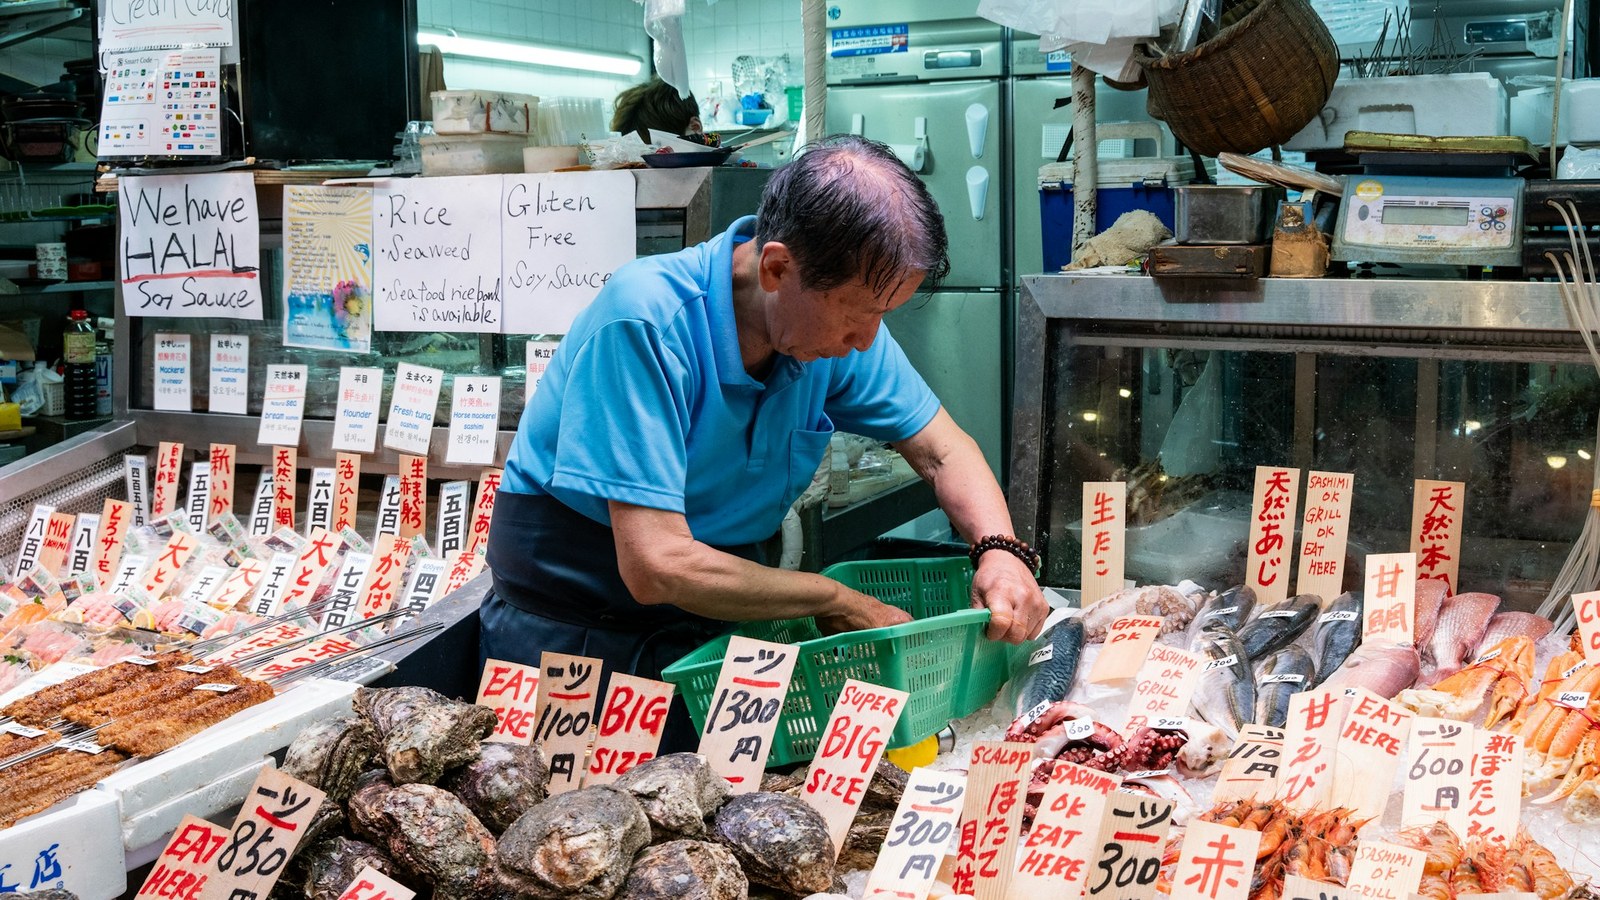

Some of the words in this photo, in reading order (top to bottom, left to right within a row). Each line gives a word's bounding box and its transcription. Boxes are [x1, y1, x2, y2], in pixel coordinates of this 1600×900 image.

[124, 185, 181, 227] We
[186, 184, 249, 226] have
[389, 194, 452, 228] Rice
[507, 182, 597, 218] Gluten
[387, 233, 472, 262] Seaweed
[527, 226, 577, 249] Free
[126, 227, 260, 280] HALAL
[508, 260, 547, 293] Soy
[548, 264, 613, 290] Sauce
[138, 281, 173, 310] Soy
[182, 276, 255, 308] Sauce
[354, 374, 368, 384] 平目
[405, 370, 433, 384] 生まぐろ
[343, 409, 372, 419] flounder
[393, 405, 413, 417] Fresh
[415, 409, 432, 421] tuna
[400, 420, 419, 430] sashimi
[453, 411, 471, 419] Horse
[471, 411, 497, 420] mackerel
[463, 422, 484, 430] sashimi
[155, 453, 167, 514] しめさば
[211, 446, 230, 514] 新いか
[275, 450, 293, 529] 天然本鯛
[410, 458, 425, 529] 生まぐろ
[1308, 475, 1349, 490] SASHIMI
[189, 474, 209, 532] 五百円
[253, 476, 274, 536] 六百円
[1322, 491, 1339, 502] OK
[379, 486, 400, 539] 七百
[442, 493, 462, 559] 五百円
[1305, 507, 1341, 523] GRILL
[48, 518, 70, 539] MIX
[1091, 492, 1115, 576] 生たこ
[1255, 471, 1291, 587] 天然あじ
[1317, 525, 1335, 537] OK
[17, 518, 45, 577] 八百円
[70, 528, 92, 577] 八百
[1303, 542, 1325, 556] EAT
[1308, 561, 1337, 576] HERE
[256, 566, 287, 618] 千六百
[323, 566, 364, 631] 七百円
[1364, 563, 1408, 637] 甘鯛
[1111, 618, 1161, 631] GRILL
[1111, 632, 1141, 643] OK
[1148, 647, 1198, 670] SASHIMI
[1161, 668, 1184, 680] OK
[1205, 658, 1233, 671] 1300
[483, 666, 539, 703] EAT
[1137, 680, 1178, 699] GRILL
[1560, 693, 1585, 702] 4000
[600, 685, 667, 737] BIG
[706, 688, 781, 734] 1300
[841, 686, 899, 718] SUPER
[1029, 704, 1046, 722] 850
[1146, 699, 1169, 712] OK
[1353, 696, 1411, 727] EAT
[533, 704, 590, 742] 1100
[1125, 715, 1149, 730] EA
[1158, 718, 1183, 727] 900
[729, 735, 762, 763] 円
[821, 716, 884, 774] BIG
[1289, 693, 1338, 803] 甘えび
[1342, 721, 1402, 756] HERE
[551, 752, 575, 783] 円
[971, 746, 1031, 774] SCALOP
[1243, 762, 1279, 778] 円
[1408, 748, 1464, 780] 600
[806, 768, 865, 805] SIZE
[1435, 786, 1459, 809] 円
[1050, 793, 1086, 818] OK
[165, 824, 228, 864] EAT
[887, 810, 953, 848] 300
[978, 779, 1021, 878] ほたて
[1024, 823, 1083, 849] EAT
[217, 820, 287, 877] 850
[1357, 847, 1413, 867] SASHIMI
[899, 854, 937, 880] 円
[1018, 849, 1086, 882] HERE
[1090, 842, 1161, 895] 300
[1184, 834, 1244, 899] 赤
[1371, 867, 1398, 880] OK
[1350, 884, 1396, 900] GRILL
